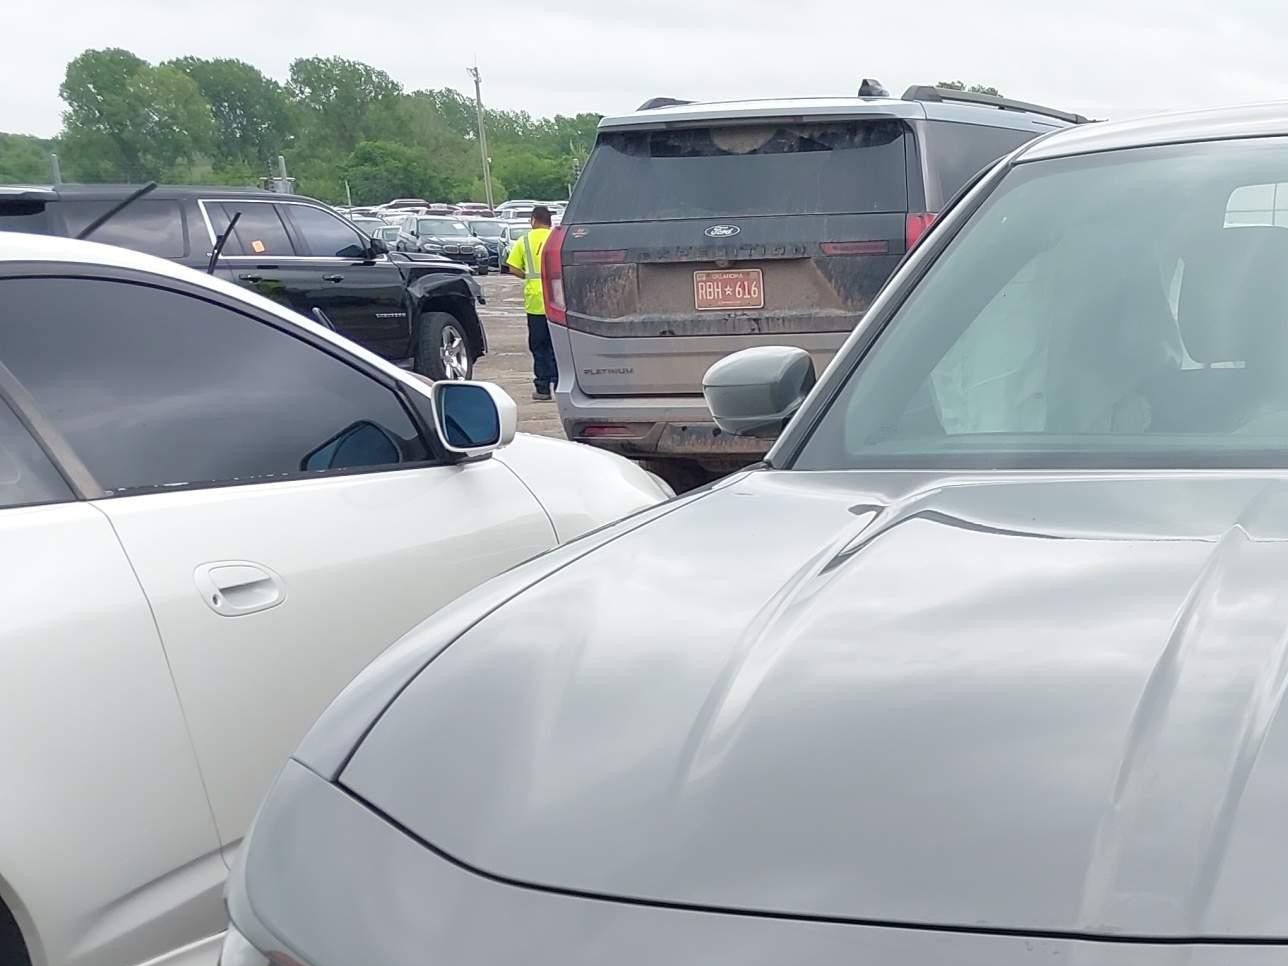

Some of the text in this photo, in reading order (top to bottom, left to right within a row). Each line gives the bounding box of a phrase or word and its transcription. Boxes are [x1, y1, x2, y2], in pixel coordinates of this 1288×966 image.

[708, 224, 735, 237] Ford
[698, 280, 759, 300] RBH 616
